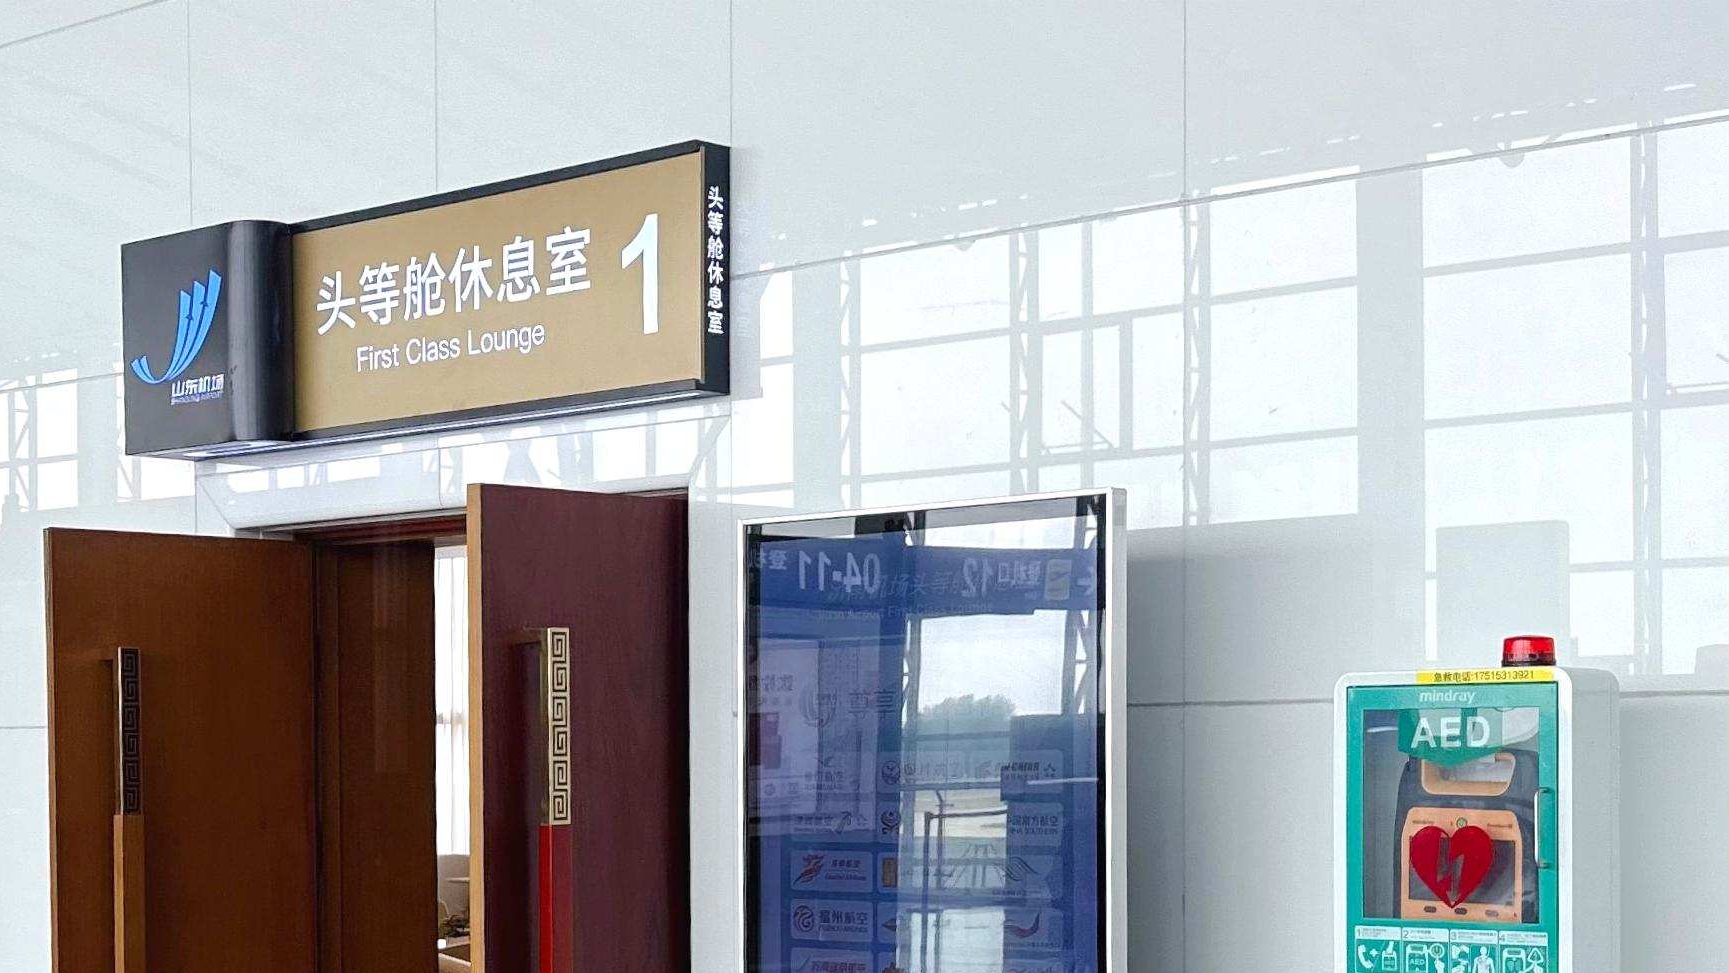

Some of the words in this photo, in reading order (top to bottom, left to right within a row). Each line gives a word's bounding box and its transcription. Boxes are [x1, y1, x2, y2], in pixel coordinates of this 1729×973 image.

[315, 226, 591, 336] 头等舱休息室
[621, 213, 659, 335] 1
[707, 185, 724, 335] 头等舱休息室
[357, 343, 400, 373] First
[405, 334, 461, 366] Class
[467, 323, 545, 355] Lounge
[171, 373, 225, 397] 山东机场
[1419, 689, 1476, 704] mindray
[1411, 716, 1490, 749] AED
